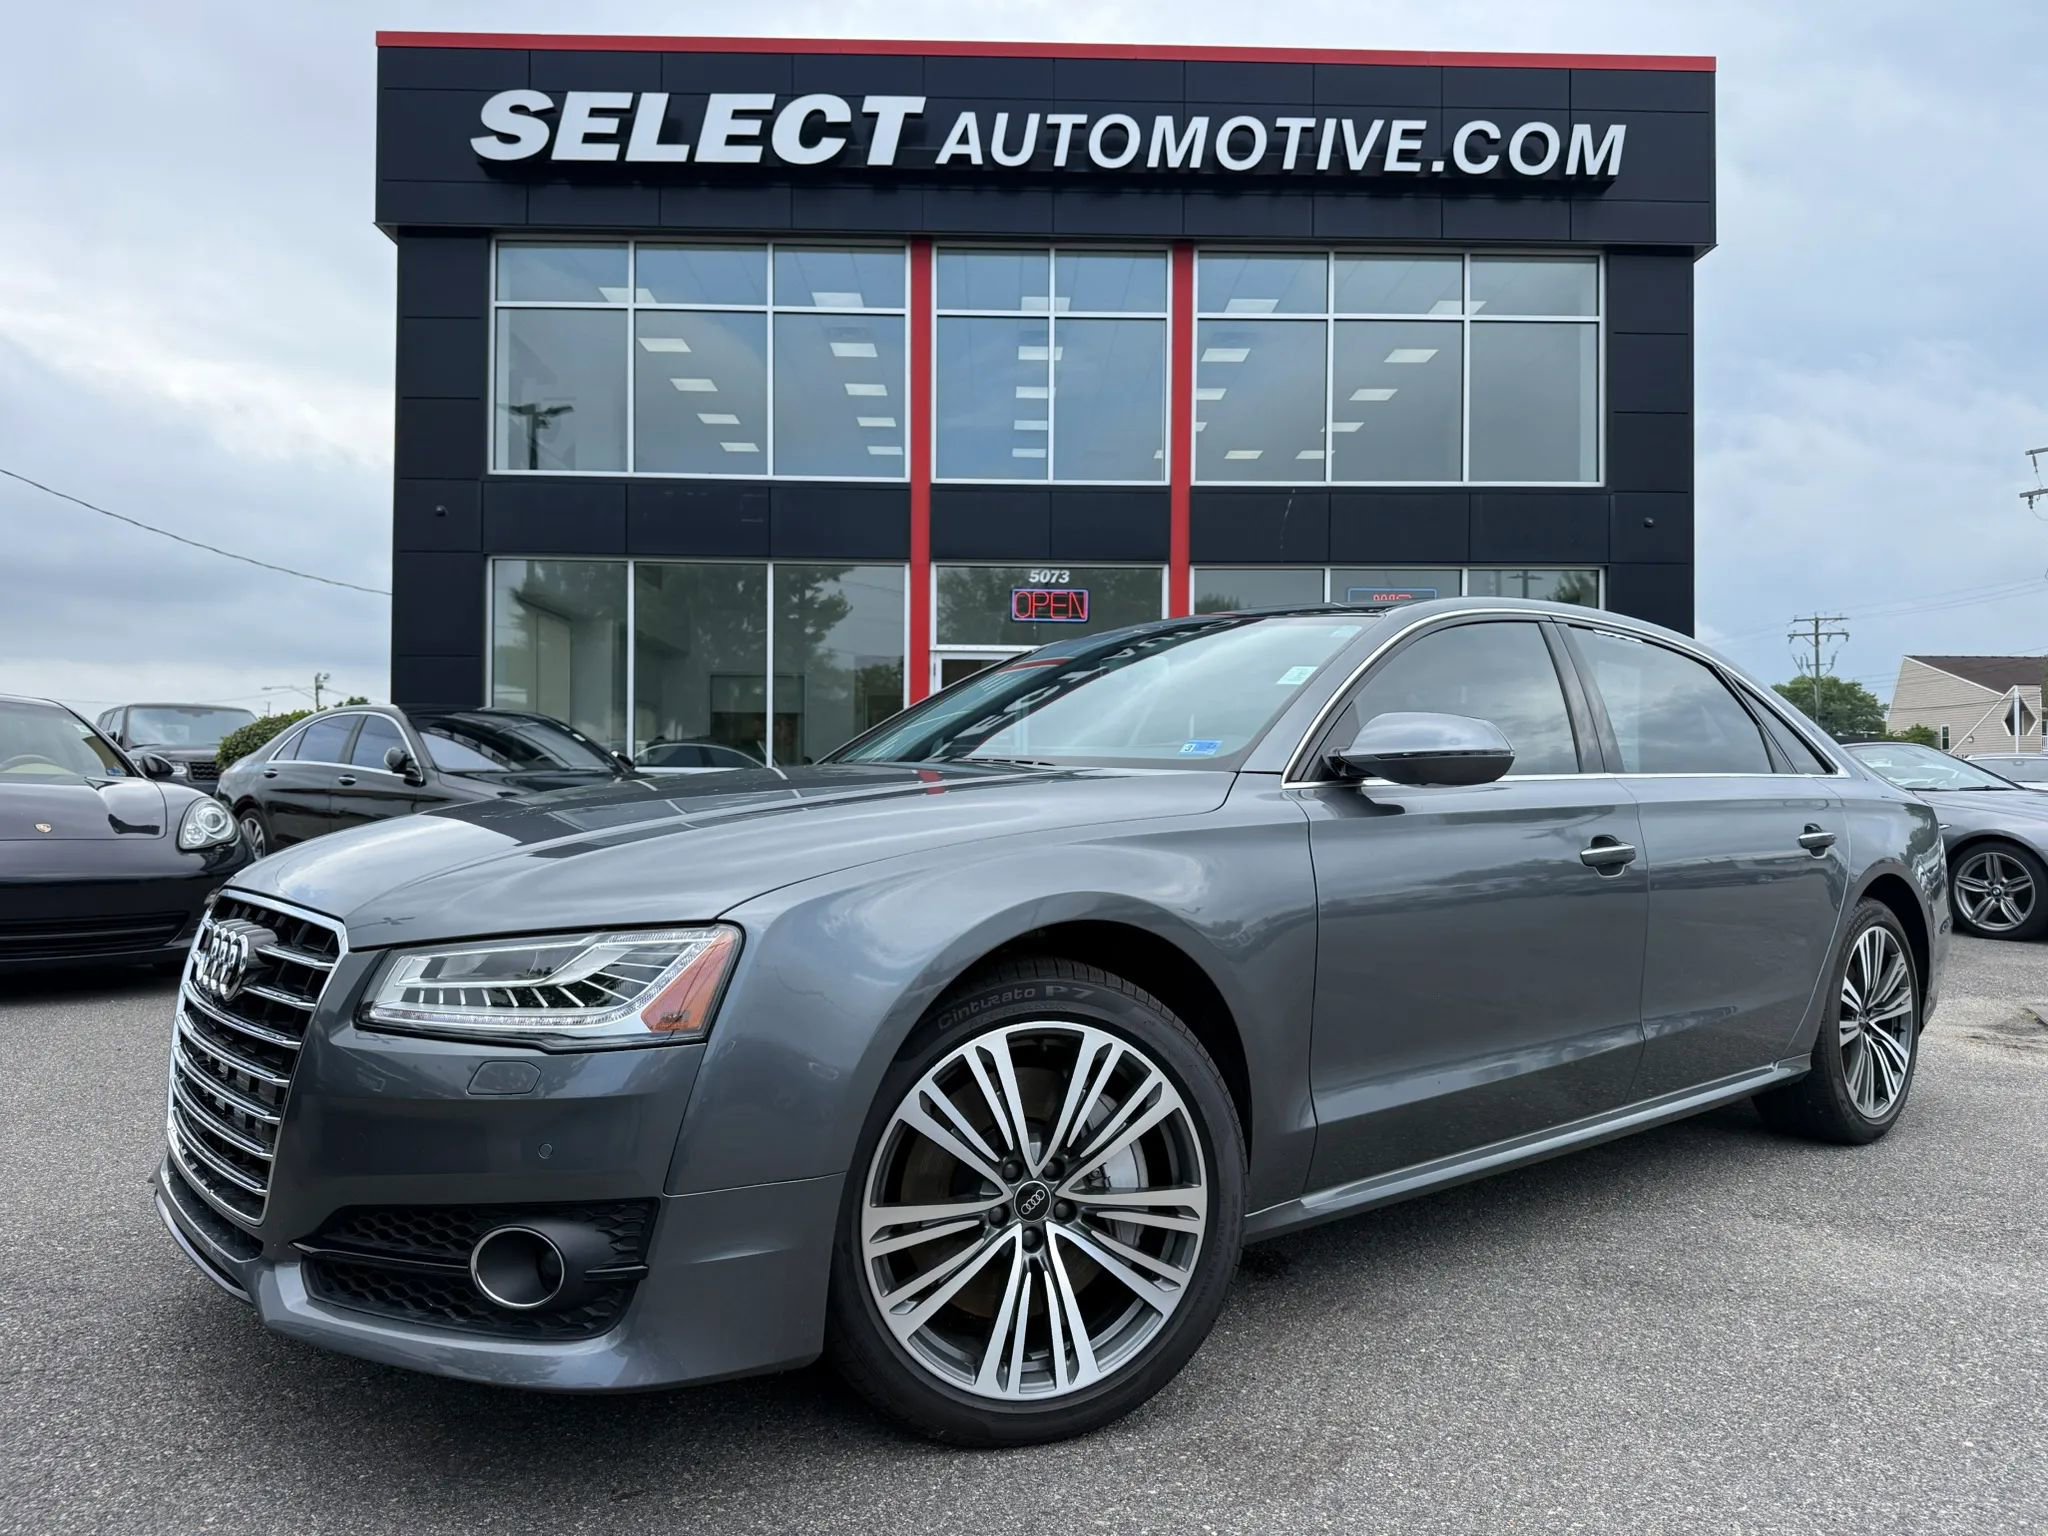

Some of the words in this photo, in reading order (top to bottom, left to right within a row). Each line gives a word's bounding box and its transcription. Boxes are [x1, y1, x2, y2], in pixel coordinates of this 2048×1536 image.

[470, 88, 927, 166] SELECT
[935, 111, 1628, 176] AUTOMOTIVE.COM
[1028, 569, 1070, 584] 5073
[1015, 591, 1085, 619] OPEN
[1045, 984, 1095, 1000] P7
